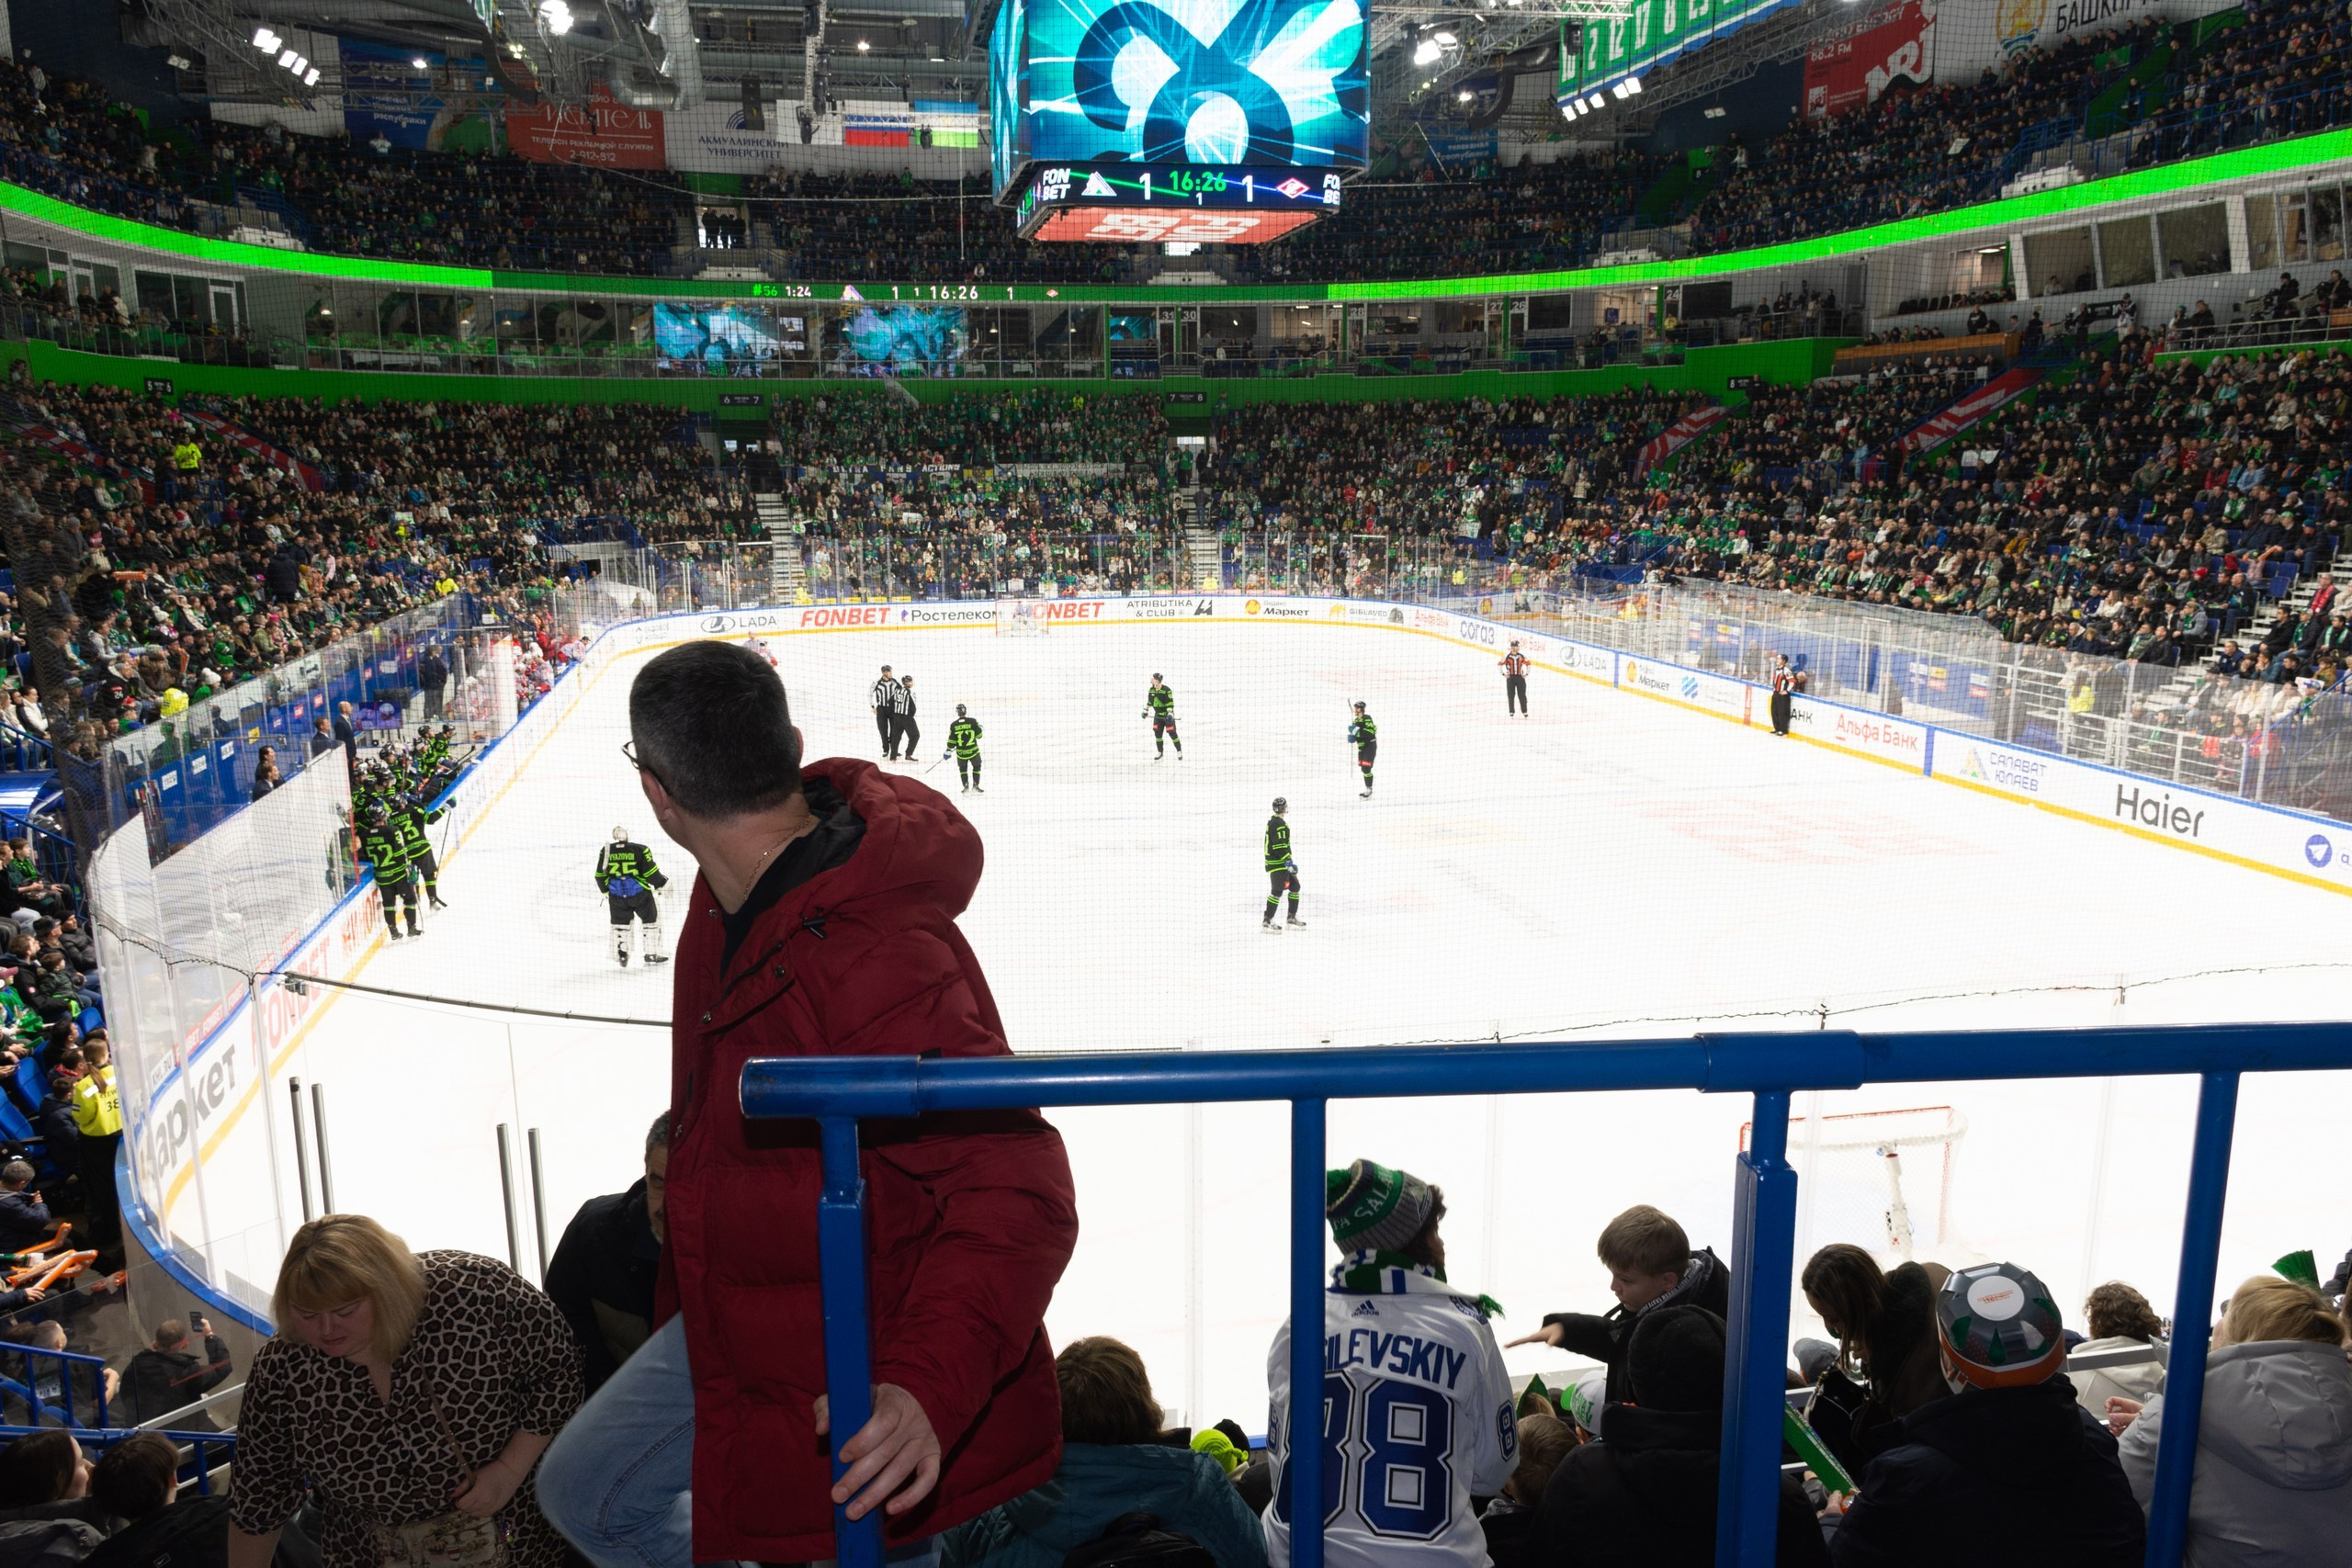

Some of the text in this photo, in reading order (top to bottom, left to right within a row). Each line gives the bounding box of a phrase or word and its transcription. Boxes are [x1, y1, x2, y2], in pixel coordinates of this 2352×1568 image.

[1633, 4, 1651, 50] 17
[1610, 18, 1624, 61] 12
[1588, 28, 1598, 71] 2
[1838, 41, 1852, 55] FM
[531, 136, 654, 152] ТЕЛЕФОН РЕКЛАМНОЙ СЛУЖБЫ
[698, 135, 789, 149] АКМУЛЛИНСКИЙ
[570, 150, 616, 163] 2-912-812
[707, 147, 781, 160] УНИВЕРСИТЕТ
[1043, 168, 1071, 186] FON
[1170, 171, 1227, 192] 16:26
[1043, 184, 1071, 201] BET
[1139, 173, 1151, 200] 1
[1242, 175, 1253, 202] 1
[1195, 193, 1203, 206] 1
[753, 284, 812, 298] #56 1:24
[891, 285, 1014, 300] 1 1 16:26 1
[1666, 288, 1679, 299] 24
[1351, 307, 1365, 317] 28
[1490, 302, 1503, 311] 27
[1512, 301, 1526, 312] 26
[1161, 310, 1175, 321] 31
[1183, 310, 1197, 321] 30
[147, 380, 153, 391] 5
[166, 381, 172, 393] 6
[1730, 378, 1736, 389] 8
[724, 396, 730, 404] 6
[753, 396, 759, 404] 7
[1170, 393, 1175, 402] 7
[1197, 393, 1204, 401] 8
[832, 463, 960, 473] ULTRA FANS ACTIONS
[1029, 602, 1105, 621] ONBET
[1126, 600, 1193, 609] ATRIBUTIKA
[800, 607, 891, 627] FONBET
[910, 610, 1003, 622] Ростелеком
[1145, 609, 1175, 617] CLUB
[1263, 607, 1309, 617] Маркет
[740, 615, 778, 628] LADA
[1461, 620, 1495, 645] согаз
[1583, 657, 1607, 670] LADA
[1639, 675, 1670, 692] Маркет
[1792, 707, 1814, 725] АНК
[955, 729, 976, 747] 72
[1838, 714, 1918, 751] Альфа Банк
[1990, 752, 2048, 776] САЛАВАТ
[1996, 770, 2039, 792] ЮЛАЕВ
[2116, 784, 2205, 837] Haier
[1277, 830, 1286, 840] 11
[367, 844, 397, 868] 52
[252, 937, 330, 1068] FONBET
[100, 1089, 119, 1099] STEW
[153, 1044, 235, 1179] аркет
[1497, 1399, 1517, 1462] 8
[1272, 1370, 1454, 1541] 88
